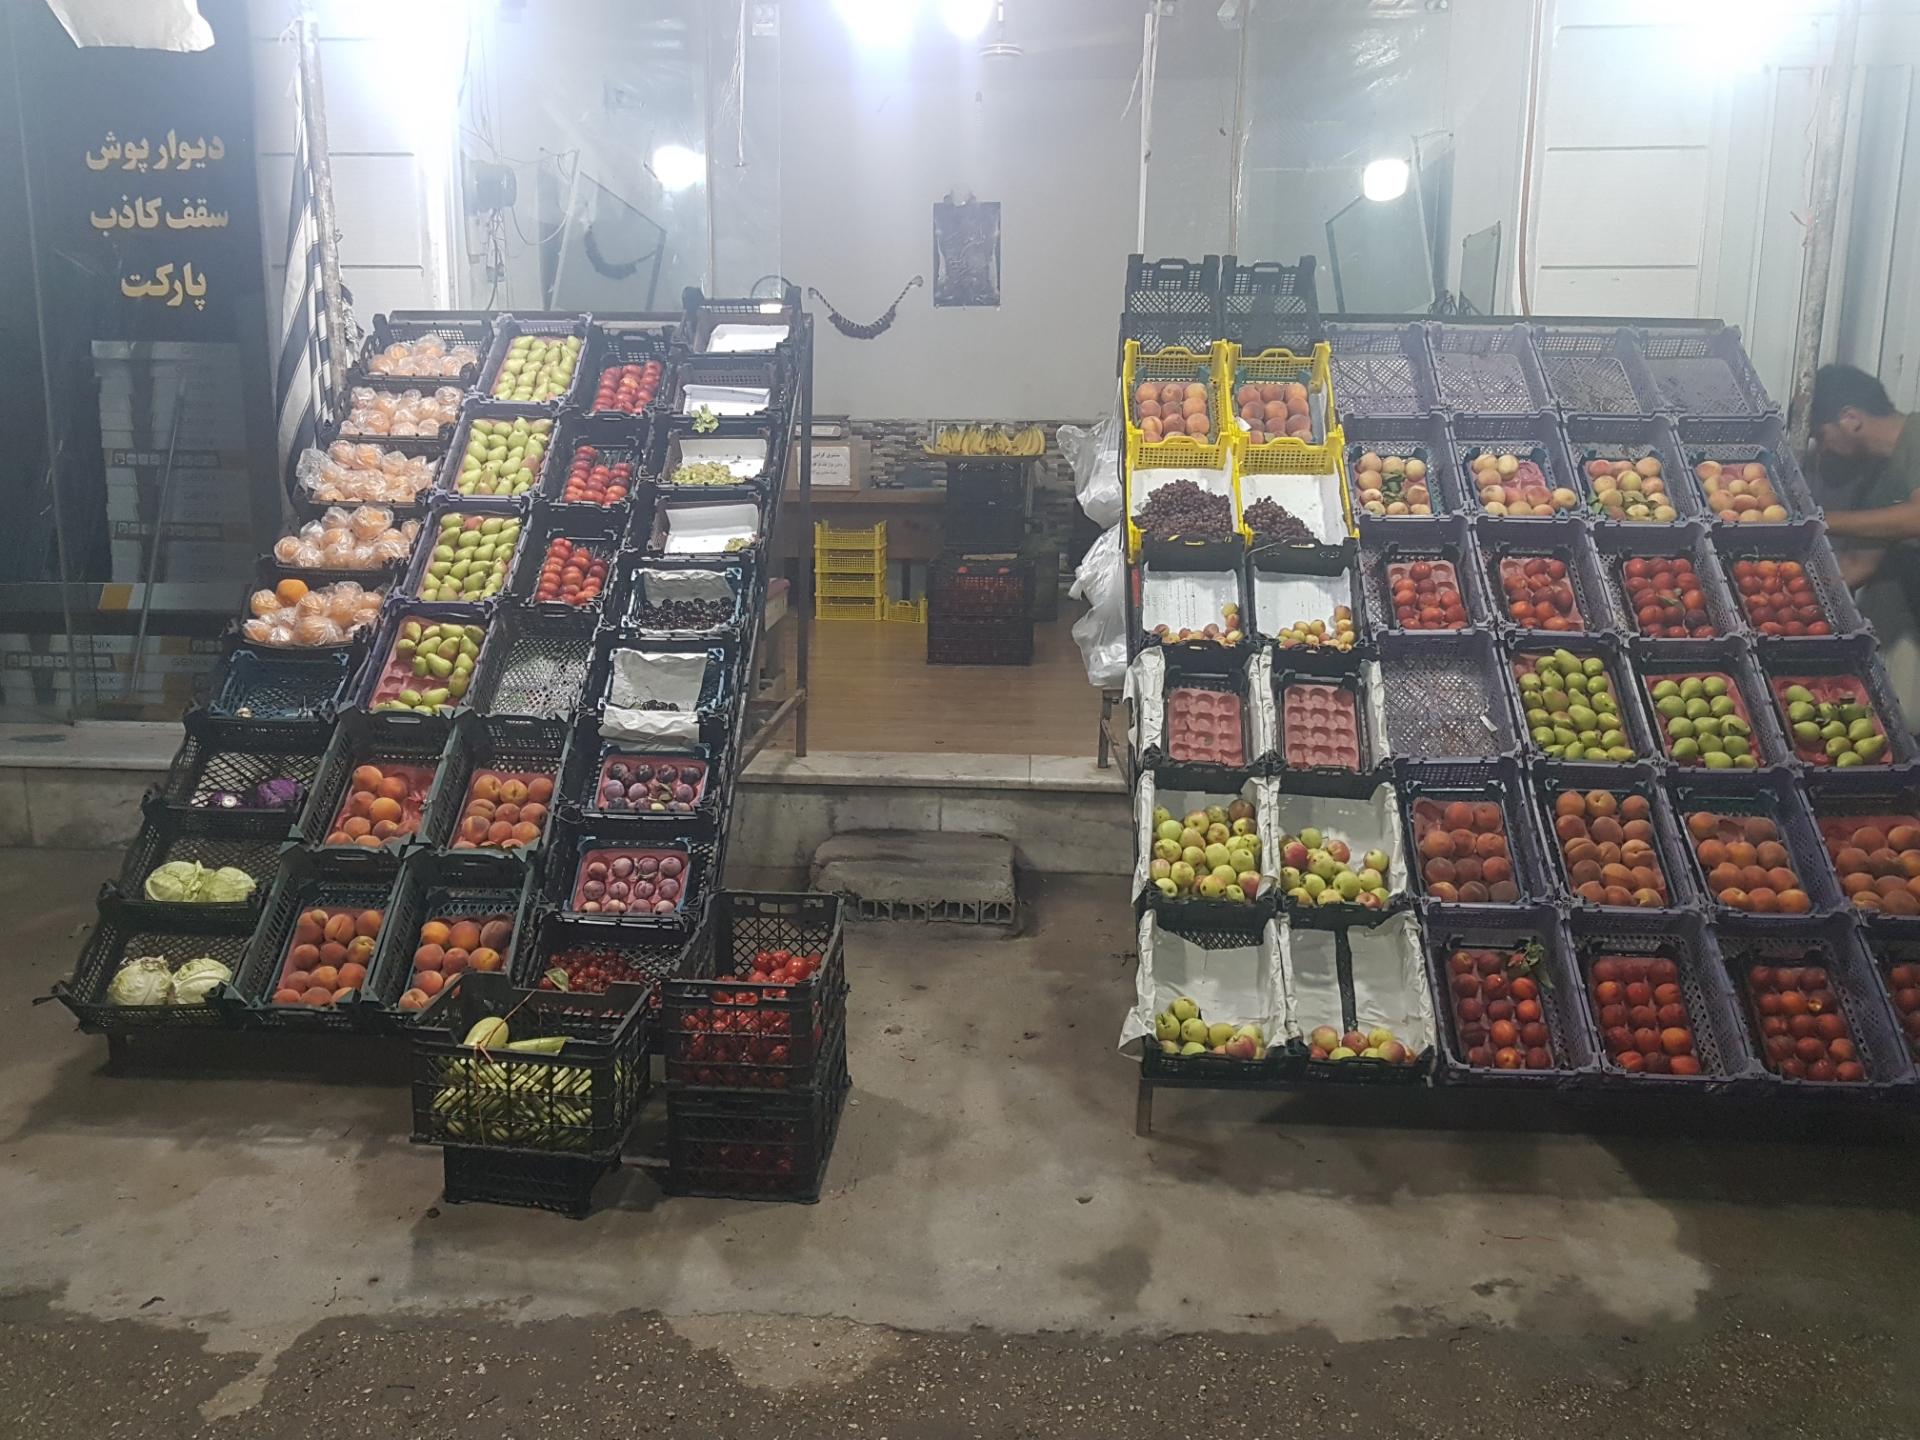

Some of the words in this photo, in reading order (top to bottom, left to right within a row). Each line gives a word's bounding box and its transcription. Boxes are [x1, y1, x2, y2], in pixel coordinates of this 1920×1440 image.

[86, 131, 149, 172] پوش
[153, 128, 225, 170] دیوار
[90, 194, 162, 237] کاذب
[165, 197, 228, 229] سقف
[121, 262, 206, 311] پارکت
